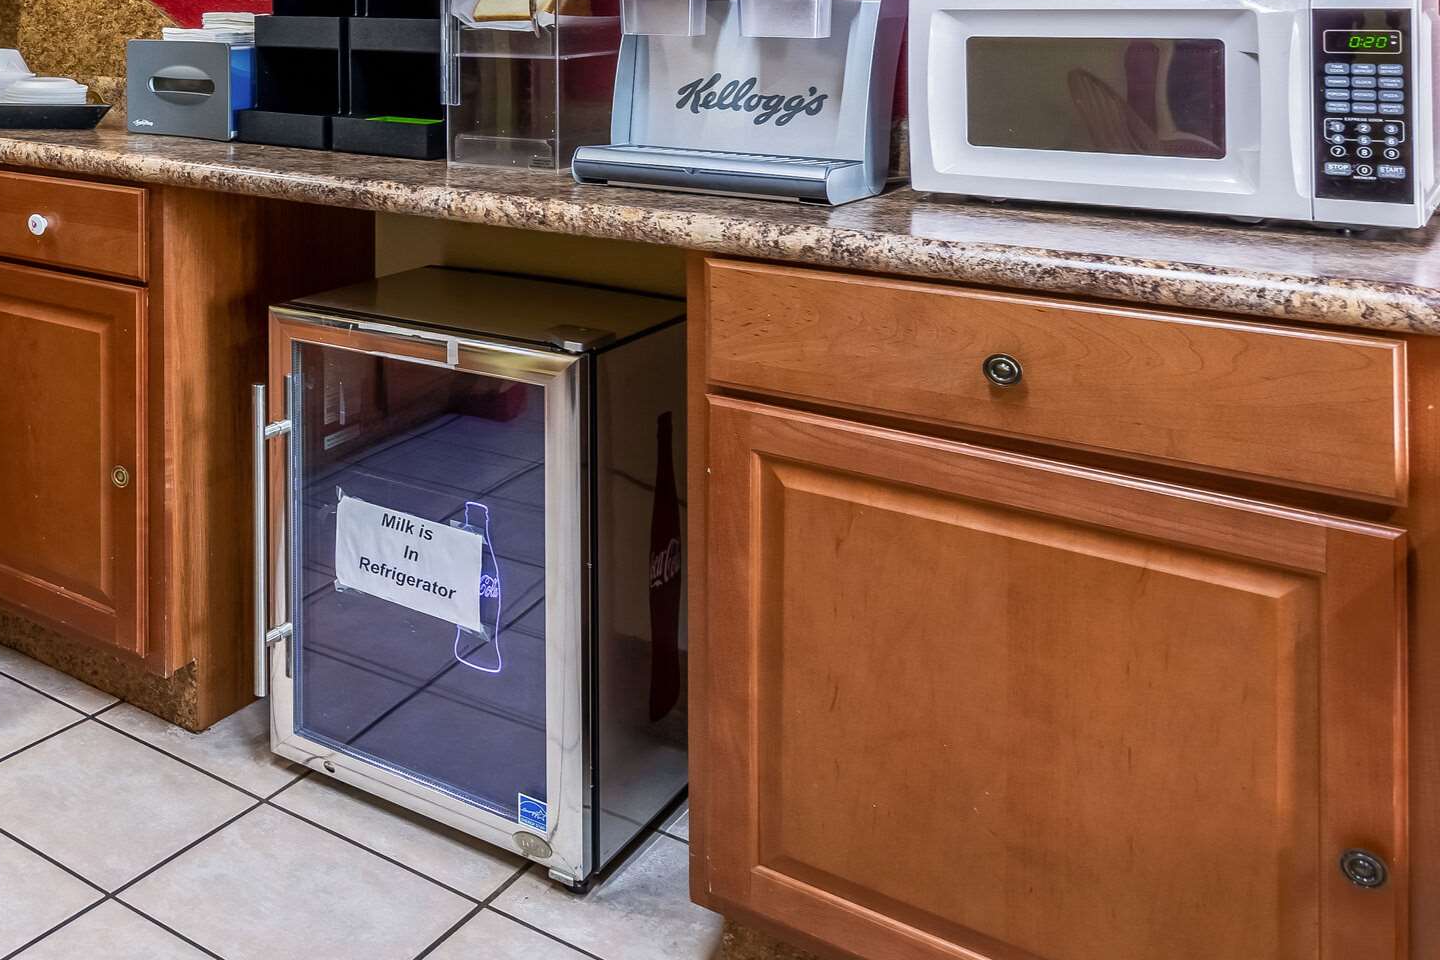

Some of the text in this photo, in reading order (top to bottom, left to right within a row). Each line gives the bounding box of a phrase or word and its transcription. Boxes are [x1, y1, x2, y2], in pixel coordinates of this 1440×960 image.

[1348, 36, 1389, 49] 0:20
[675, 72, 829, 127] Kellogg's
[381, 513, 433, 541] Milk is
[403, 545, 419, 562] In
[359, 556, 457, 600] Refrigerator
